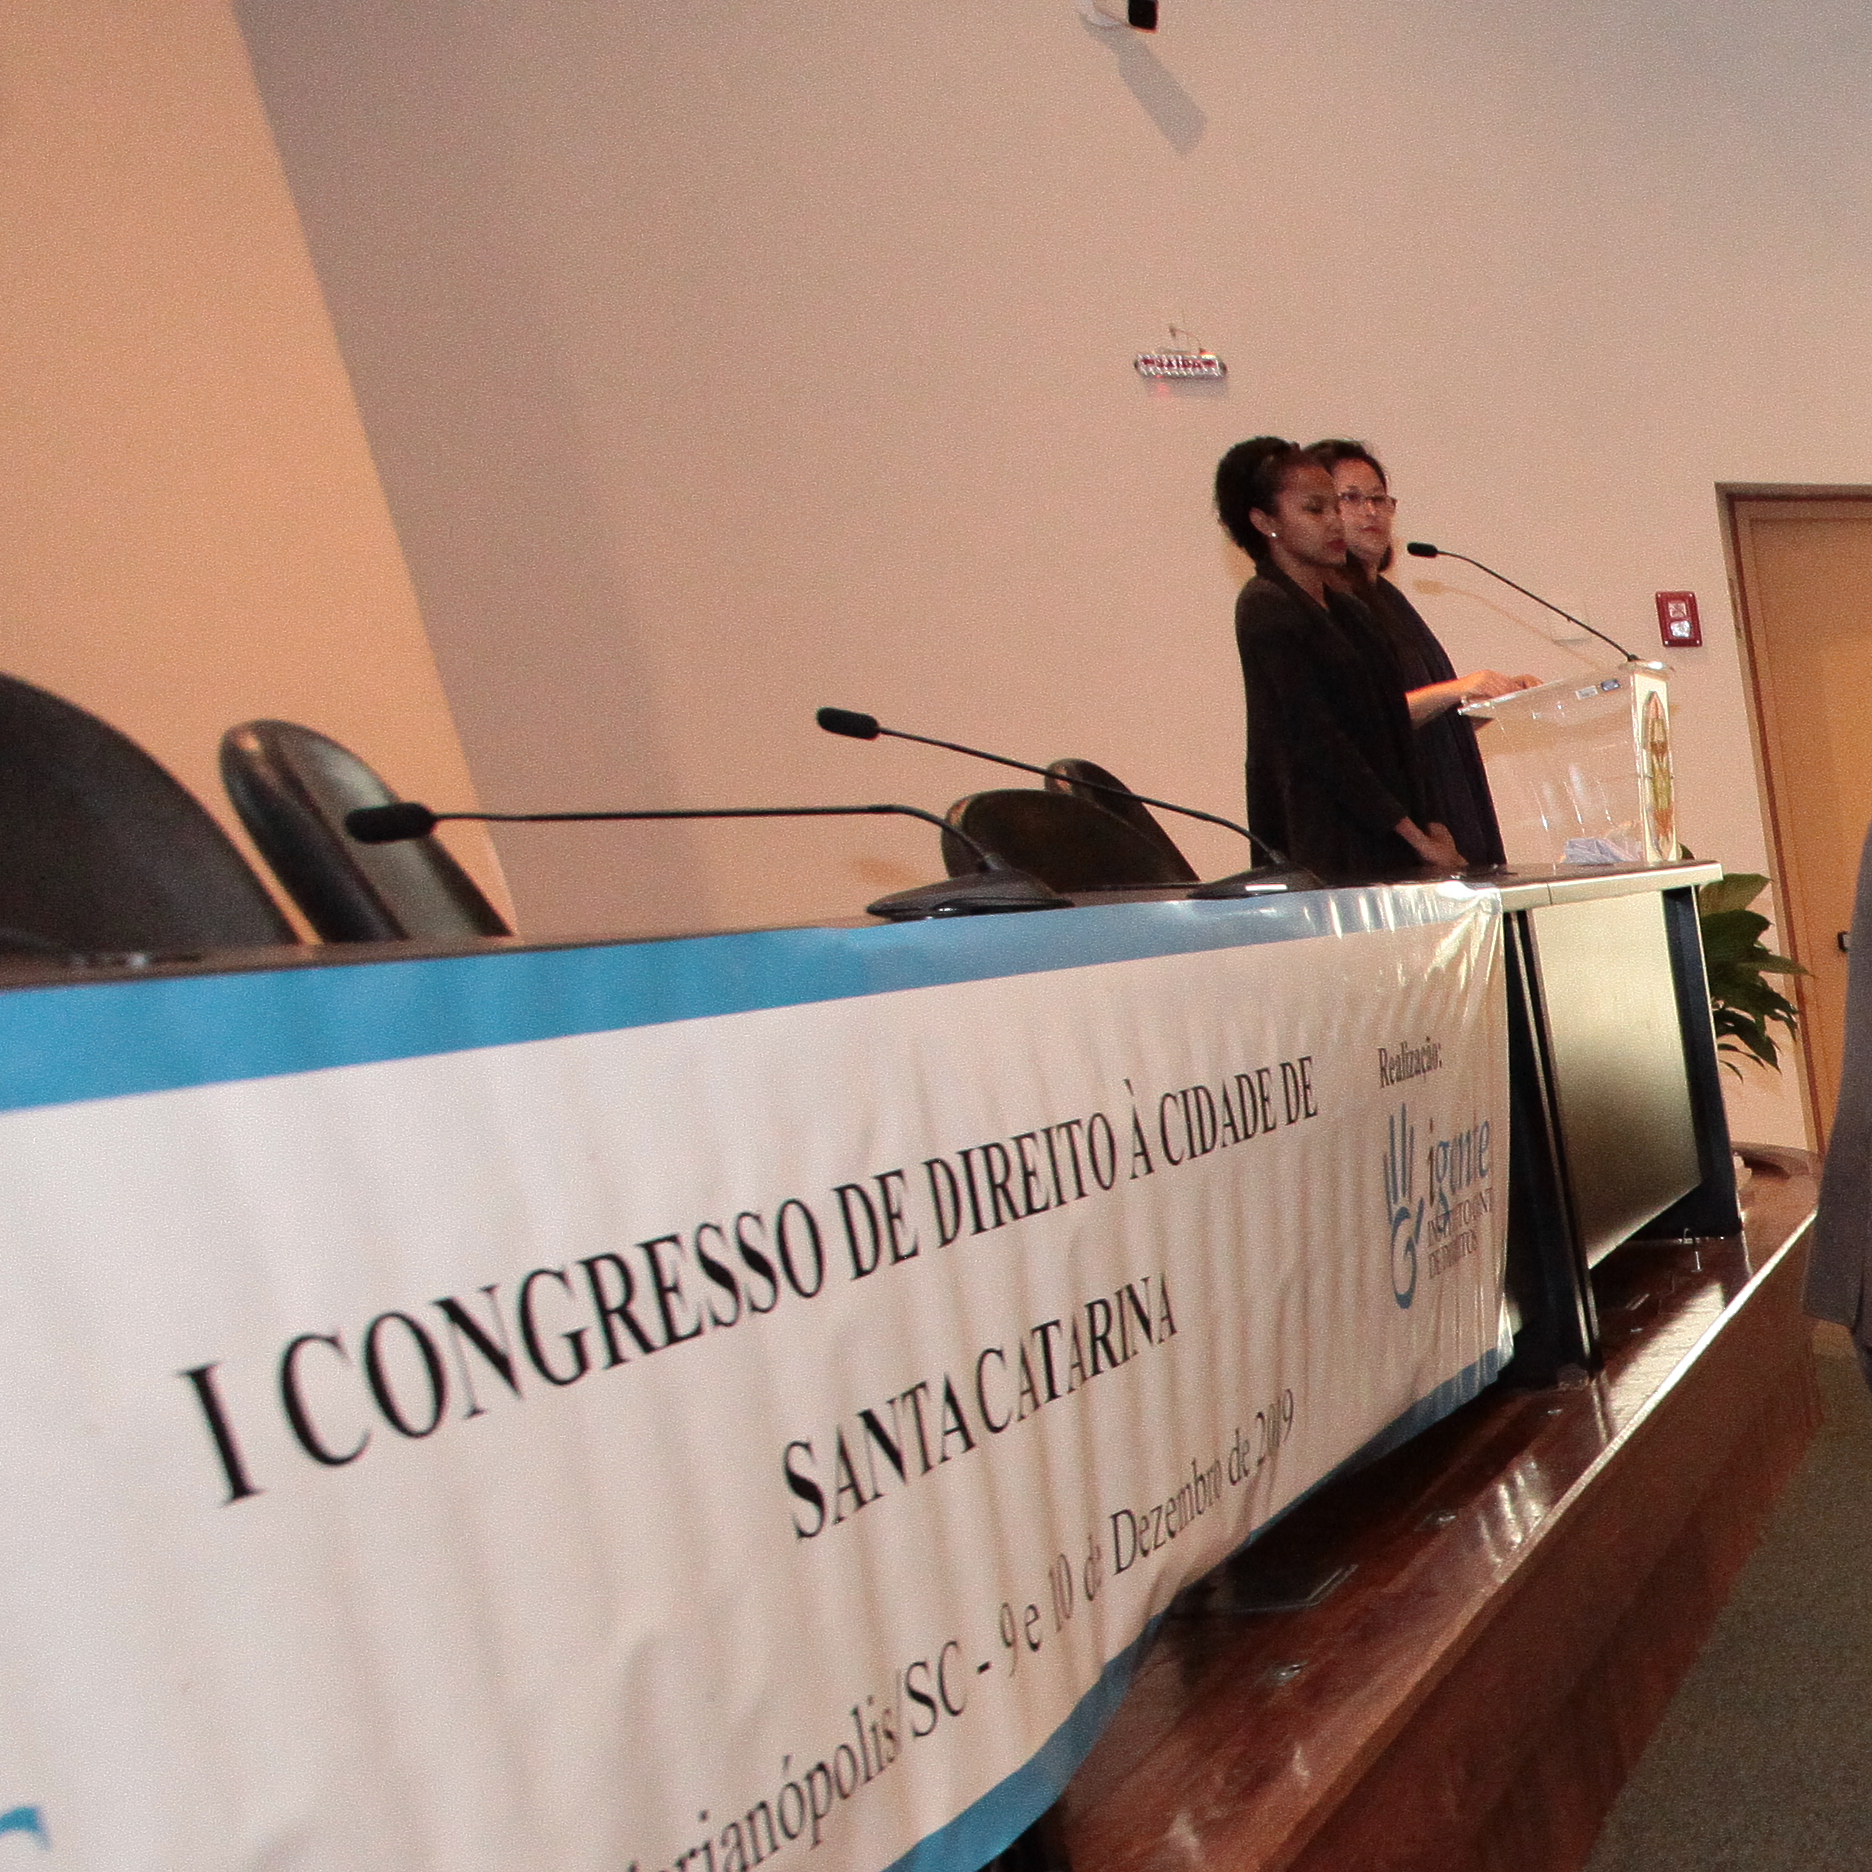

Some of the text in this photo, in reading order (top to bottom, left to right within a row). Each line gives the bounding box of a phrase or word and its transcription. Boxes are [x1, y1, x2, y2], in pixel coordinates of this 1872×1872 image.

[180, 1055, 1319, 1507] I CONGRESSO DE DIREITO À CIDADE DE
[782, 1271, 1179, 1540] SANTA CATARINA
[1000, 1602, 1018, 1677] 9
[1024, 1603, 1042, 1652] e
[1048, 1553, 1073, 1633] 10
[1109, 1457, 1223, 1577] Dezembro
[1228, 1427, 1251, 1486] de
